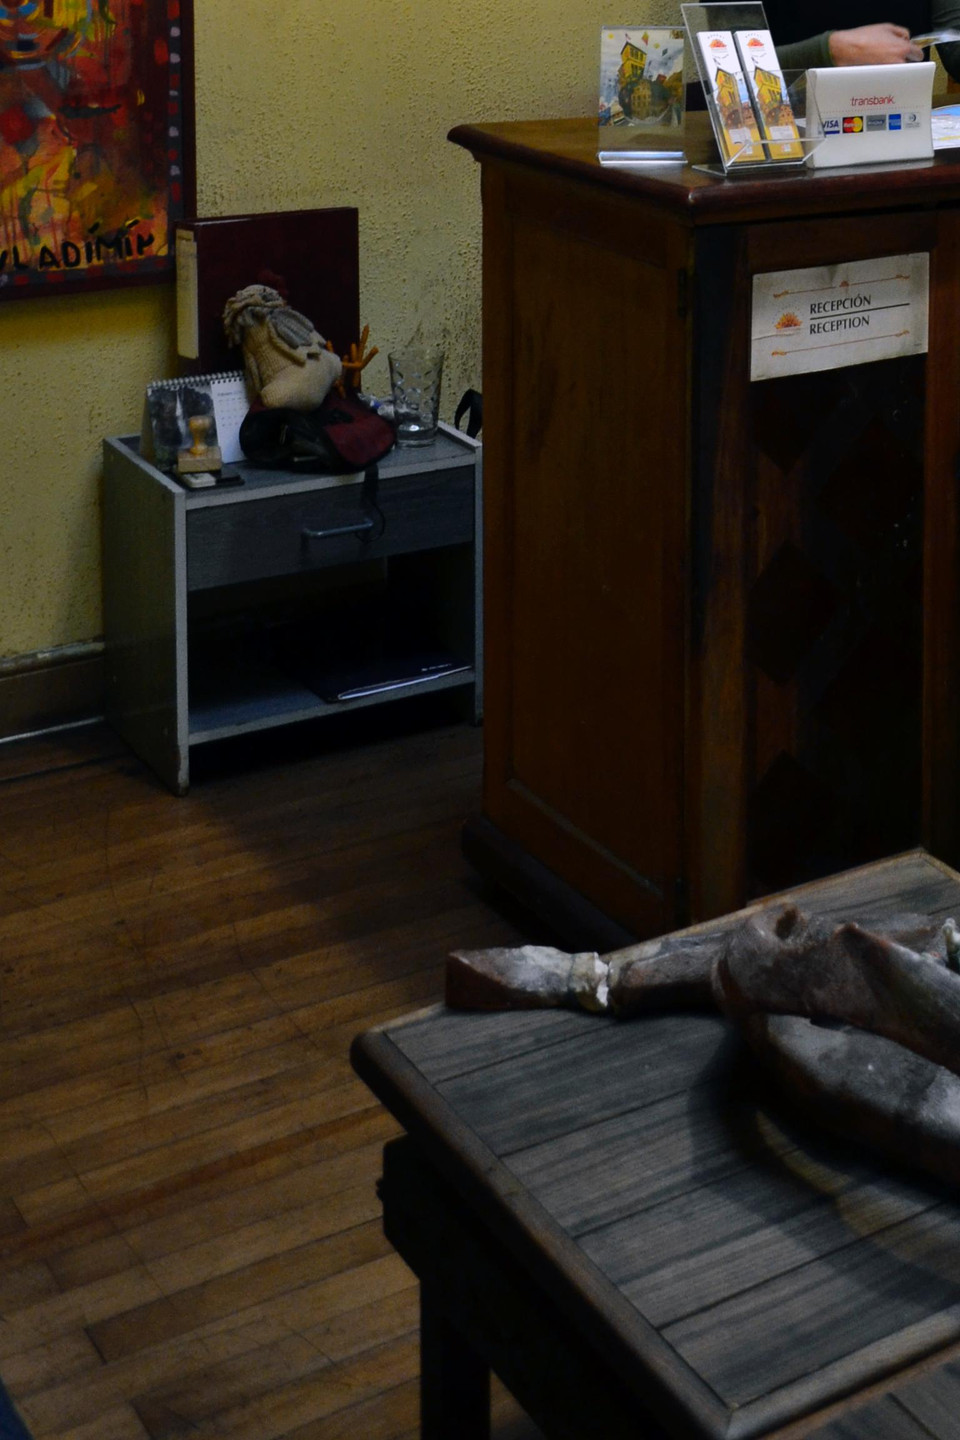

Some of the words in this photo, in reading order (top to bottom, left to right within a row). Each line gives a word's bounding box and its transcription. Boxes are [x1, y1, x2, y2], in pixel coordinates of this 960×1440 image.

[851, 94, 895, 107] transbank
[822, 119, 840, 129] VISA
[810, 293, 872, 315] RECEPCIÓN
[809, 314, 870, 335] RECEPTION
